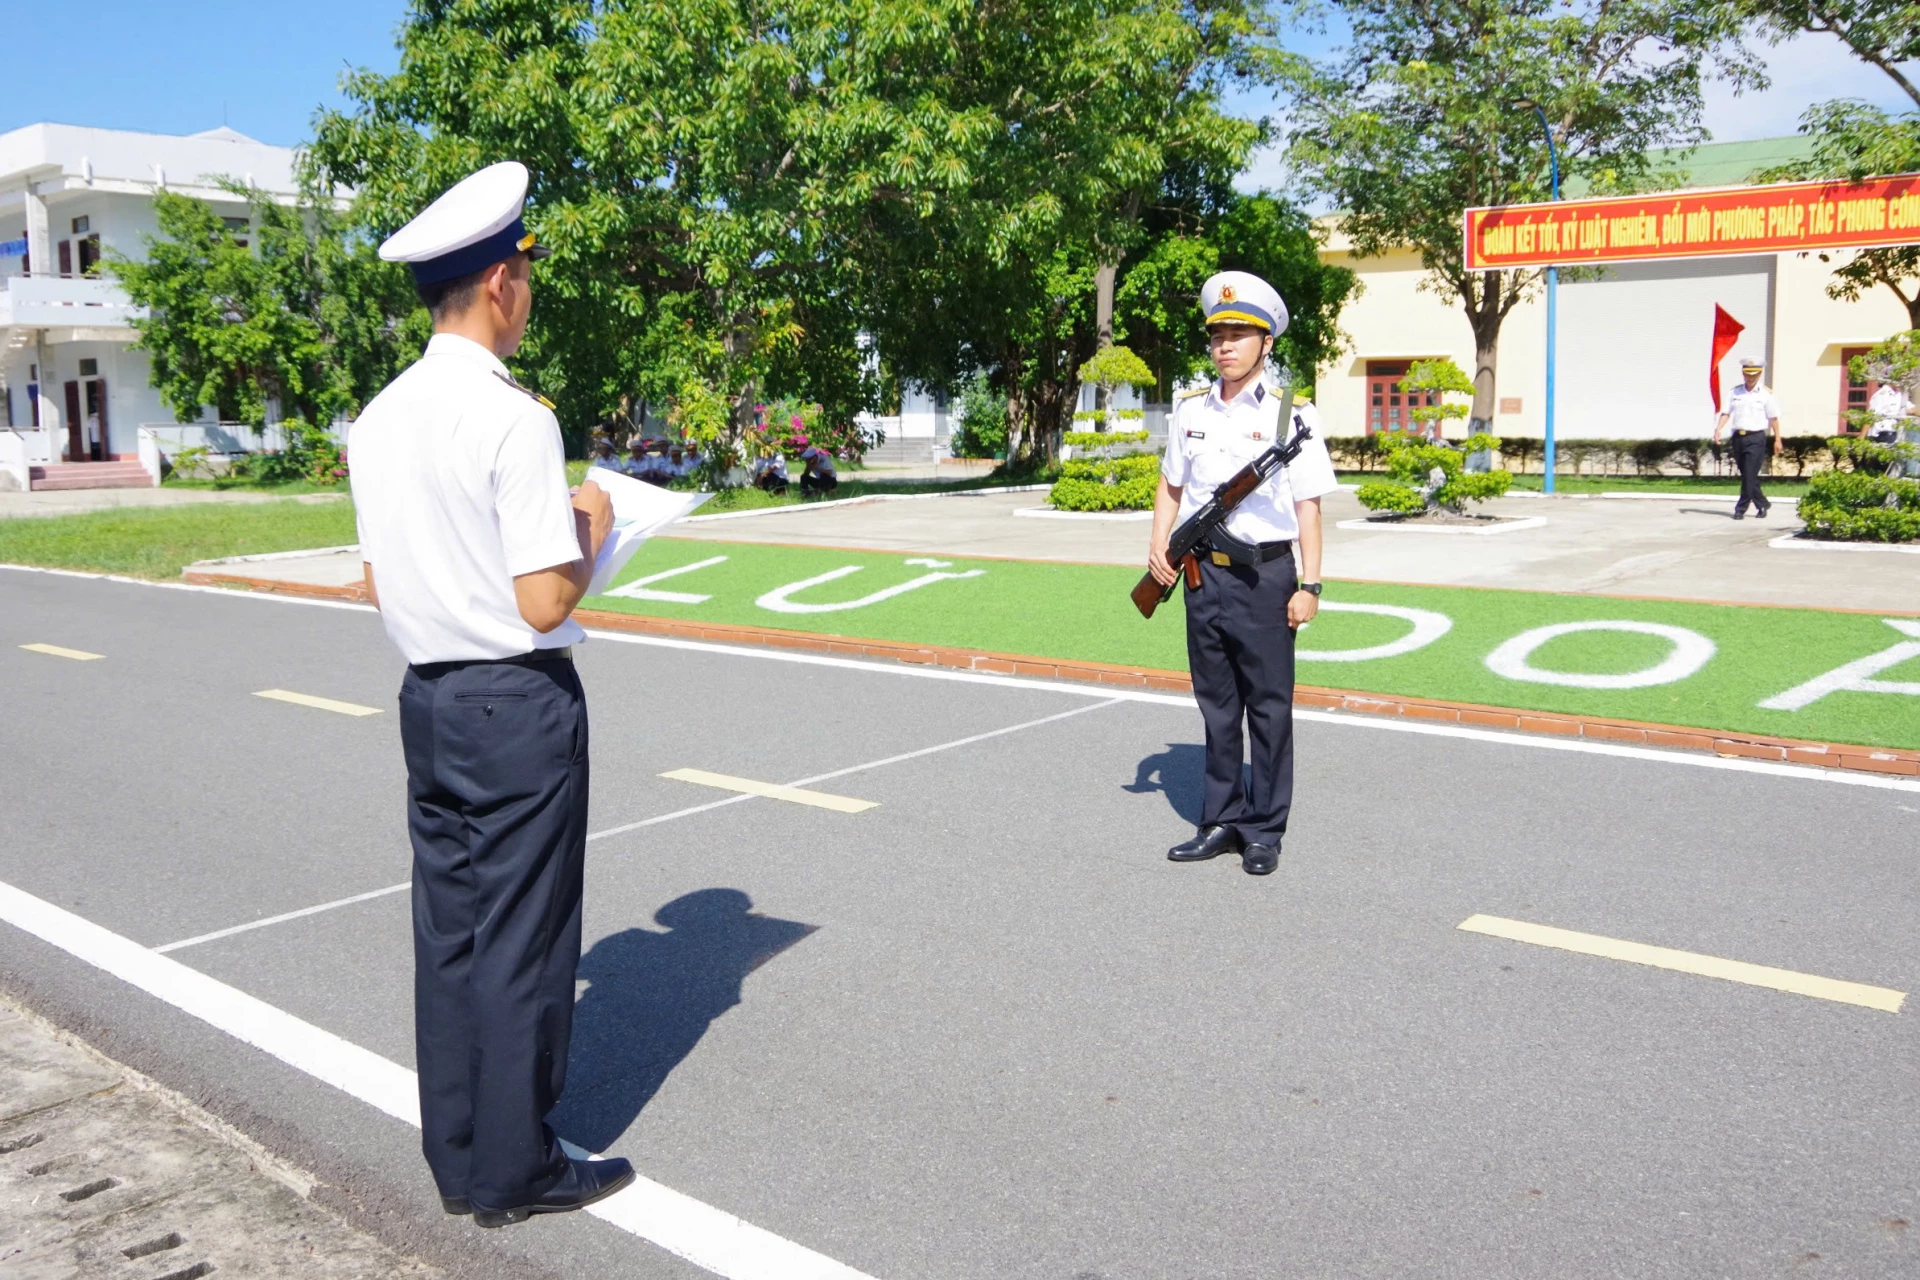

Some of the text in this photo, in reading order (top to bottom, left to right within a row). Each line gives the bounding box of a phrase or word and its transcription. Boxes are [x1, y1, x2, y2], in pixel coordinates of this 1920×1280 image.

[1516, 214, 1536, 253] KẾT
[1538, 212, 1560, 255] TỐT,
[1562, 211, 1578, 251] KỶ
[1580, 213, 1608, 255] LUẬT
[1610, 209, 1659, 248] NGHIÊM,
[1662, 201, 1684, 244] ĐỔI
[1686, 204, 1711, 243] MỚI
[1713, 205, 1765, 241] PHƯƠNG
[1768, 198, 1805, 240] PHÁP,
[1809, 195, 1835, 235] TÁC
[1837, 197, 1886, 233] PHONG
